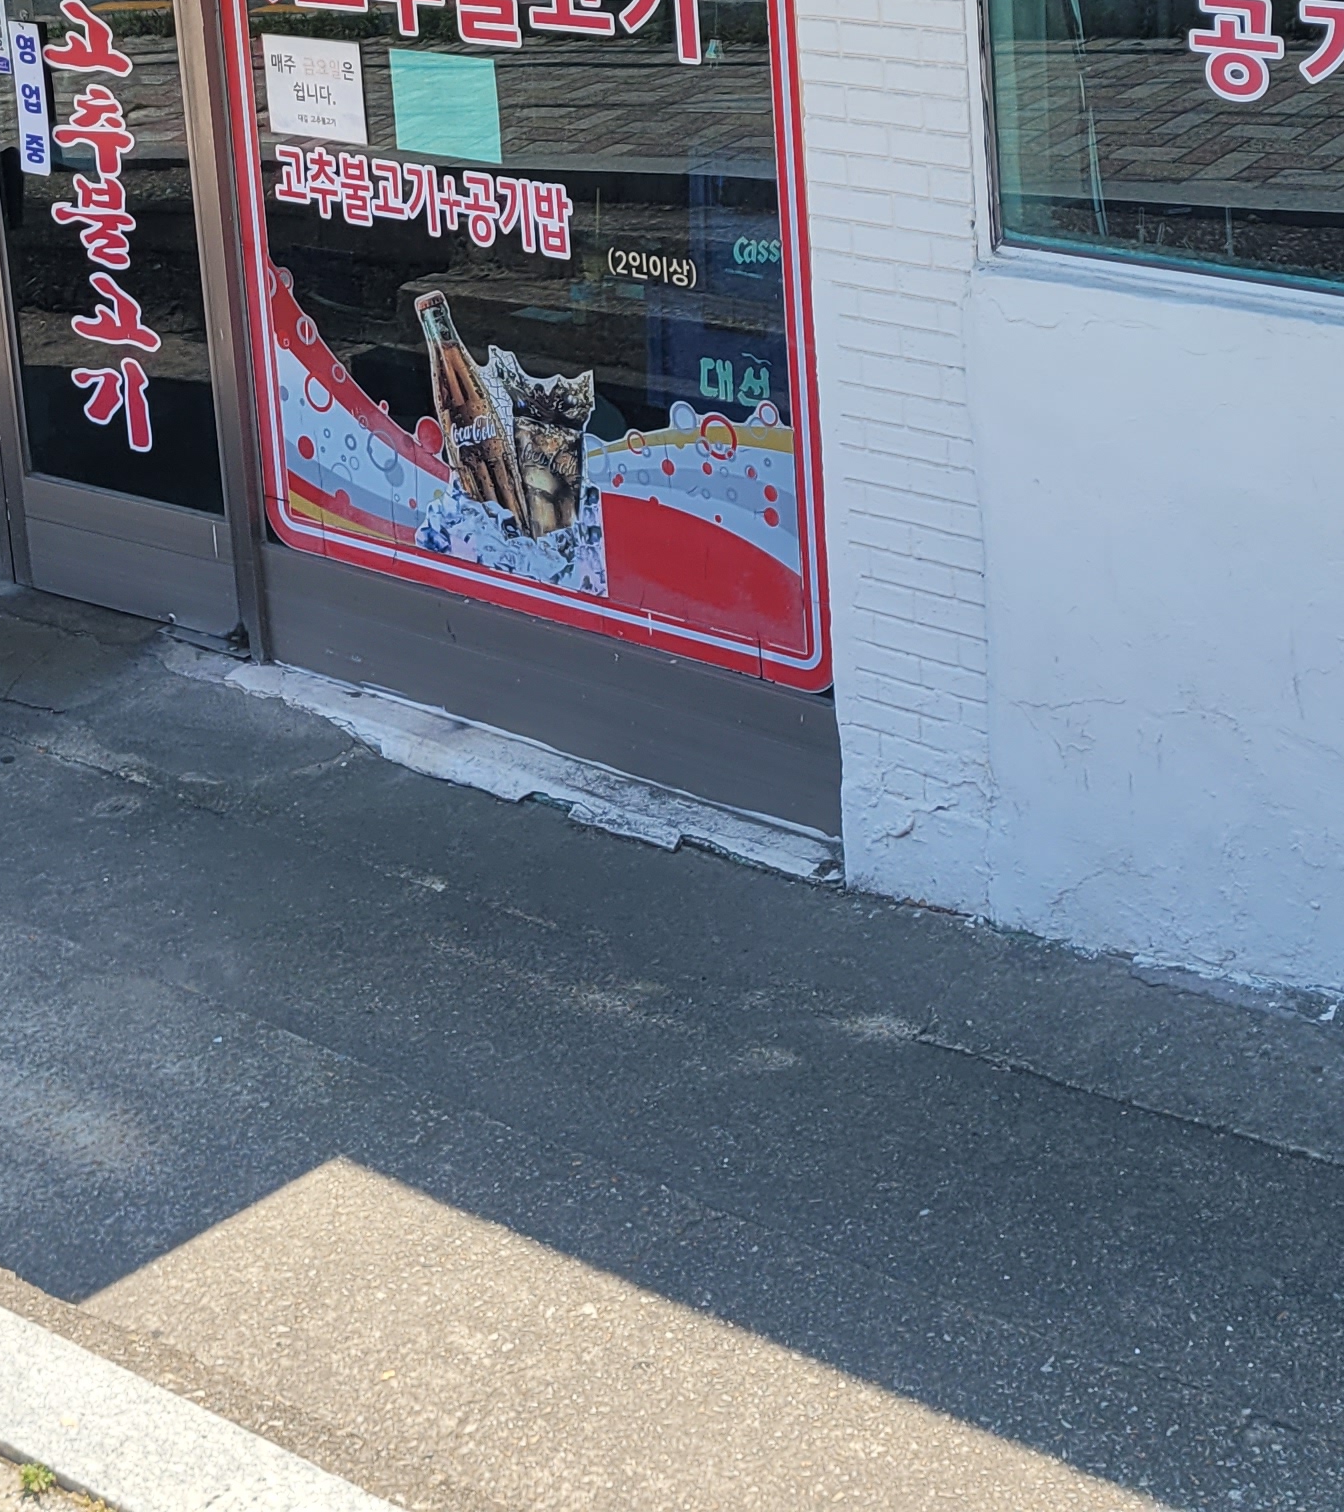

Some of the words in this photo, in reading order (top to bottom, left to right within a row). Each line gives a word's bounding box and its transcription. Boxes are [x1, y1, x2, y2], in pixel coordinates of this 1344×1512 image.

[270, 53, 297, 74] 매주
[293, 81, 337, 106] 쉽니다.
[275, 144, 573, 260] 고추불고기+공기밥
[733, 234, 781, 265] Cass
[607, 246, 698, 288] (2인이상)
